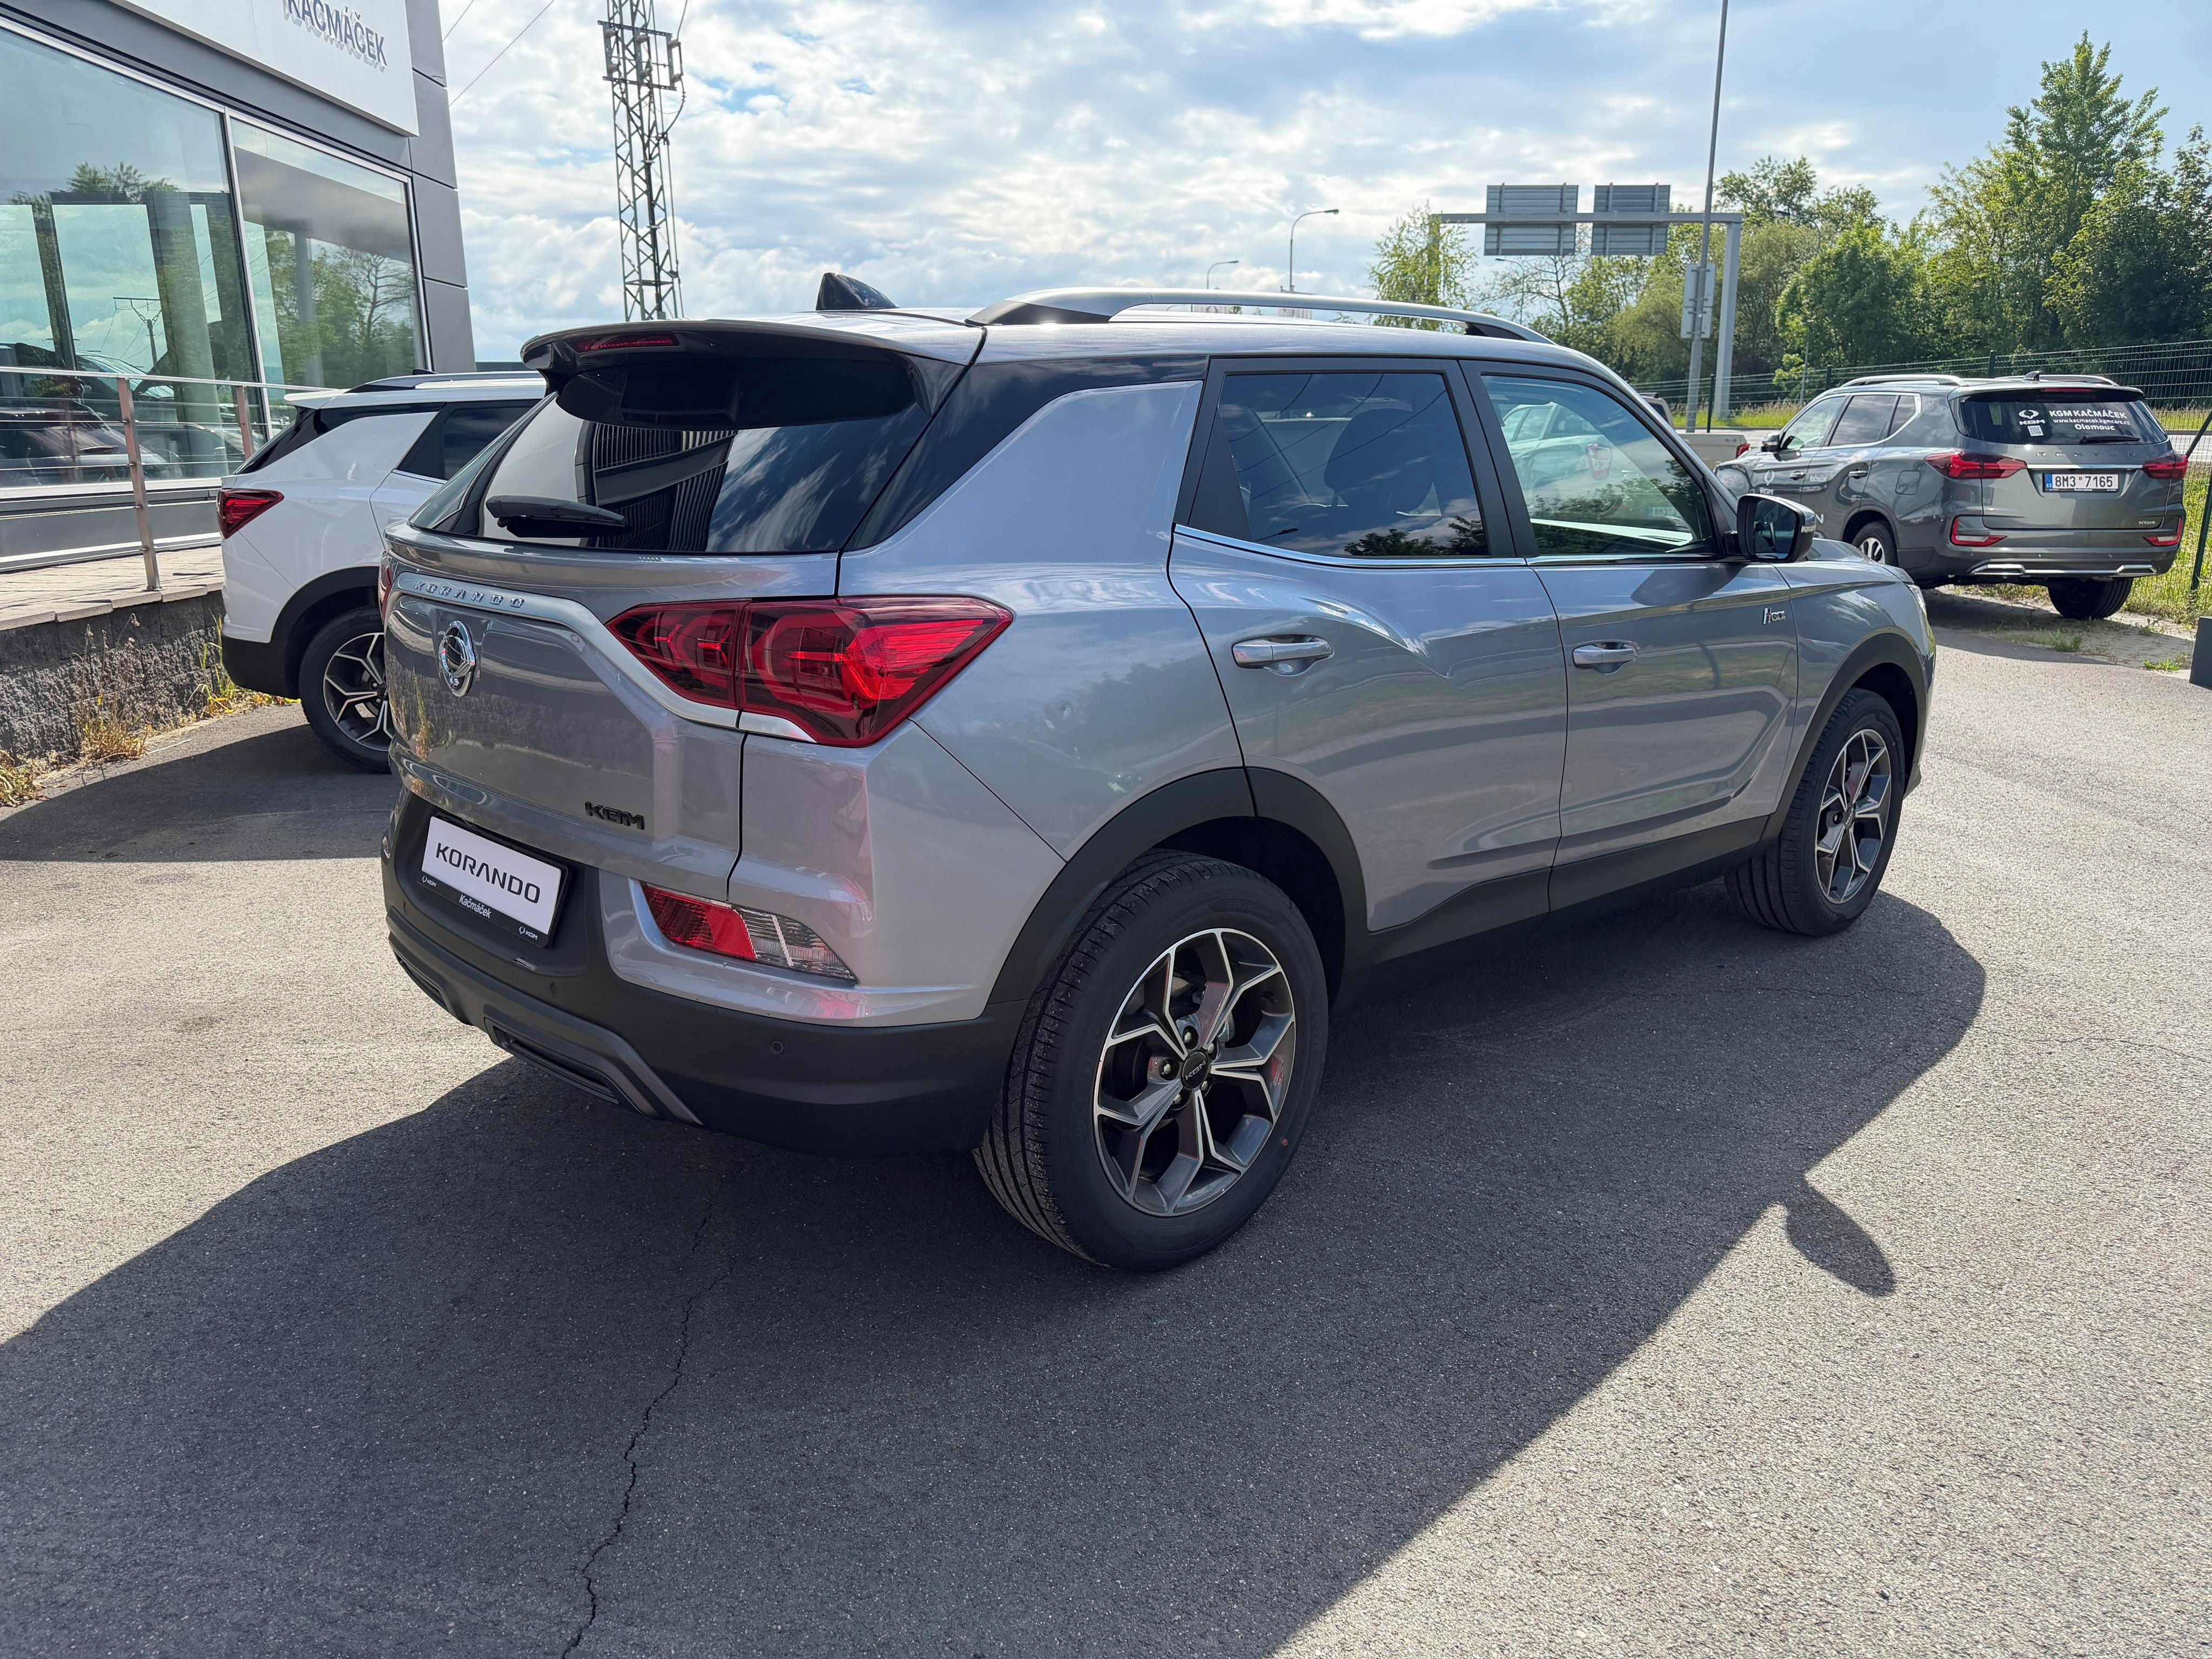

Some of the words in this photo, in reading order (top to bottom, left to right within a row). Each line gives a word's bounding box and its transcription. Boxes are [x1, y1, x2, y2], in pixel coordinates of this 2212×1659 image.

[2073, 409, 2127, 419] KAČMÁČEK
[2055, 476, 2076, 487] 8M3
[2085, 476, 2113, 487] 7165
[413, 580, 525, 608] KORANDO
[584, 801, 645, 831] KGM
[435, 842, 541, 904] KORANDO
[458, 894, 492, 919] Kačmáček
[525, 930, 538, 940] KGM
[1185, 1060, 1207, 1081] KGM
